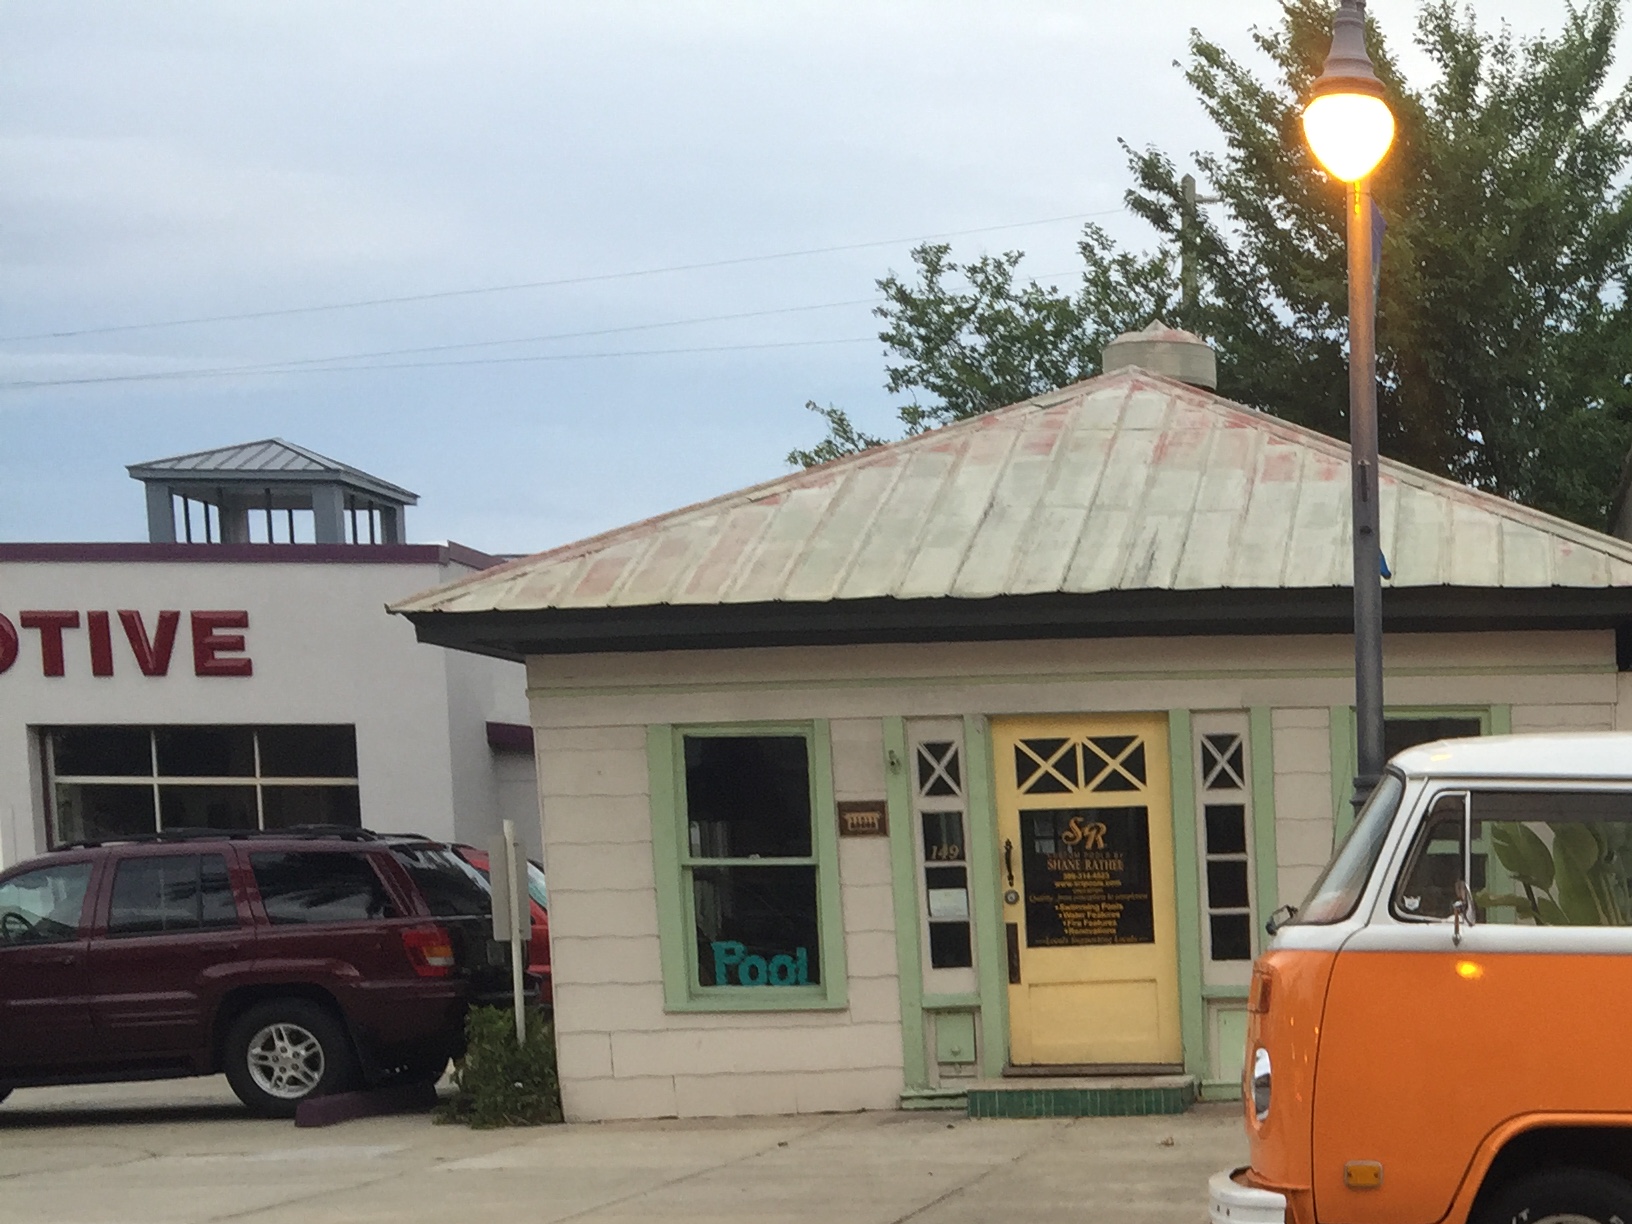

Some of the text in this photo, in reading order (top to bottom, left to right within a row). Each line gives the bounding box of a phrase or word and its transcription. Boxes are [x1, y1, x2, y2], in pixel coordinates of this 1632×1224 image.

[0, 610, 253, 677] TIVE
[930, 845, 960, 860] 149
[710, 941, 808, 987] Pool
